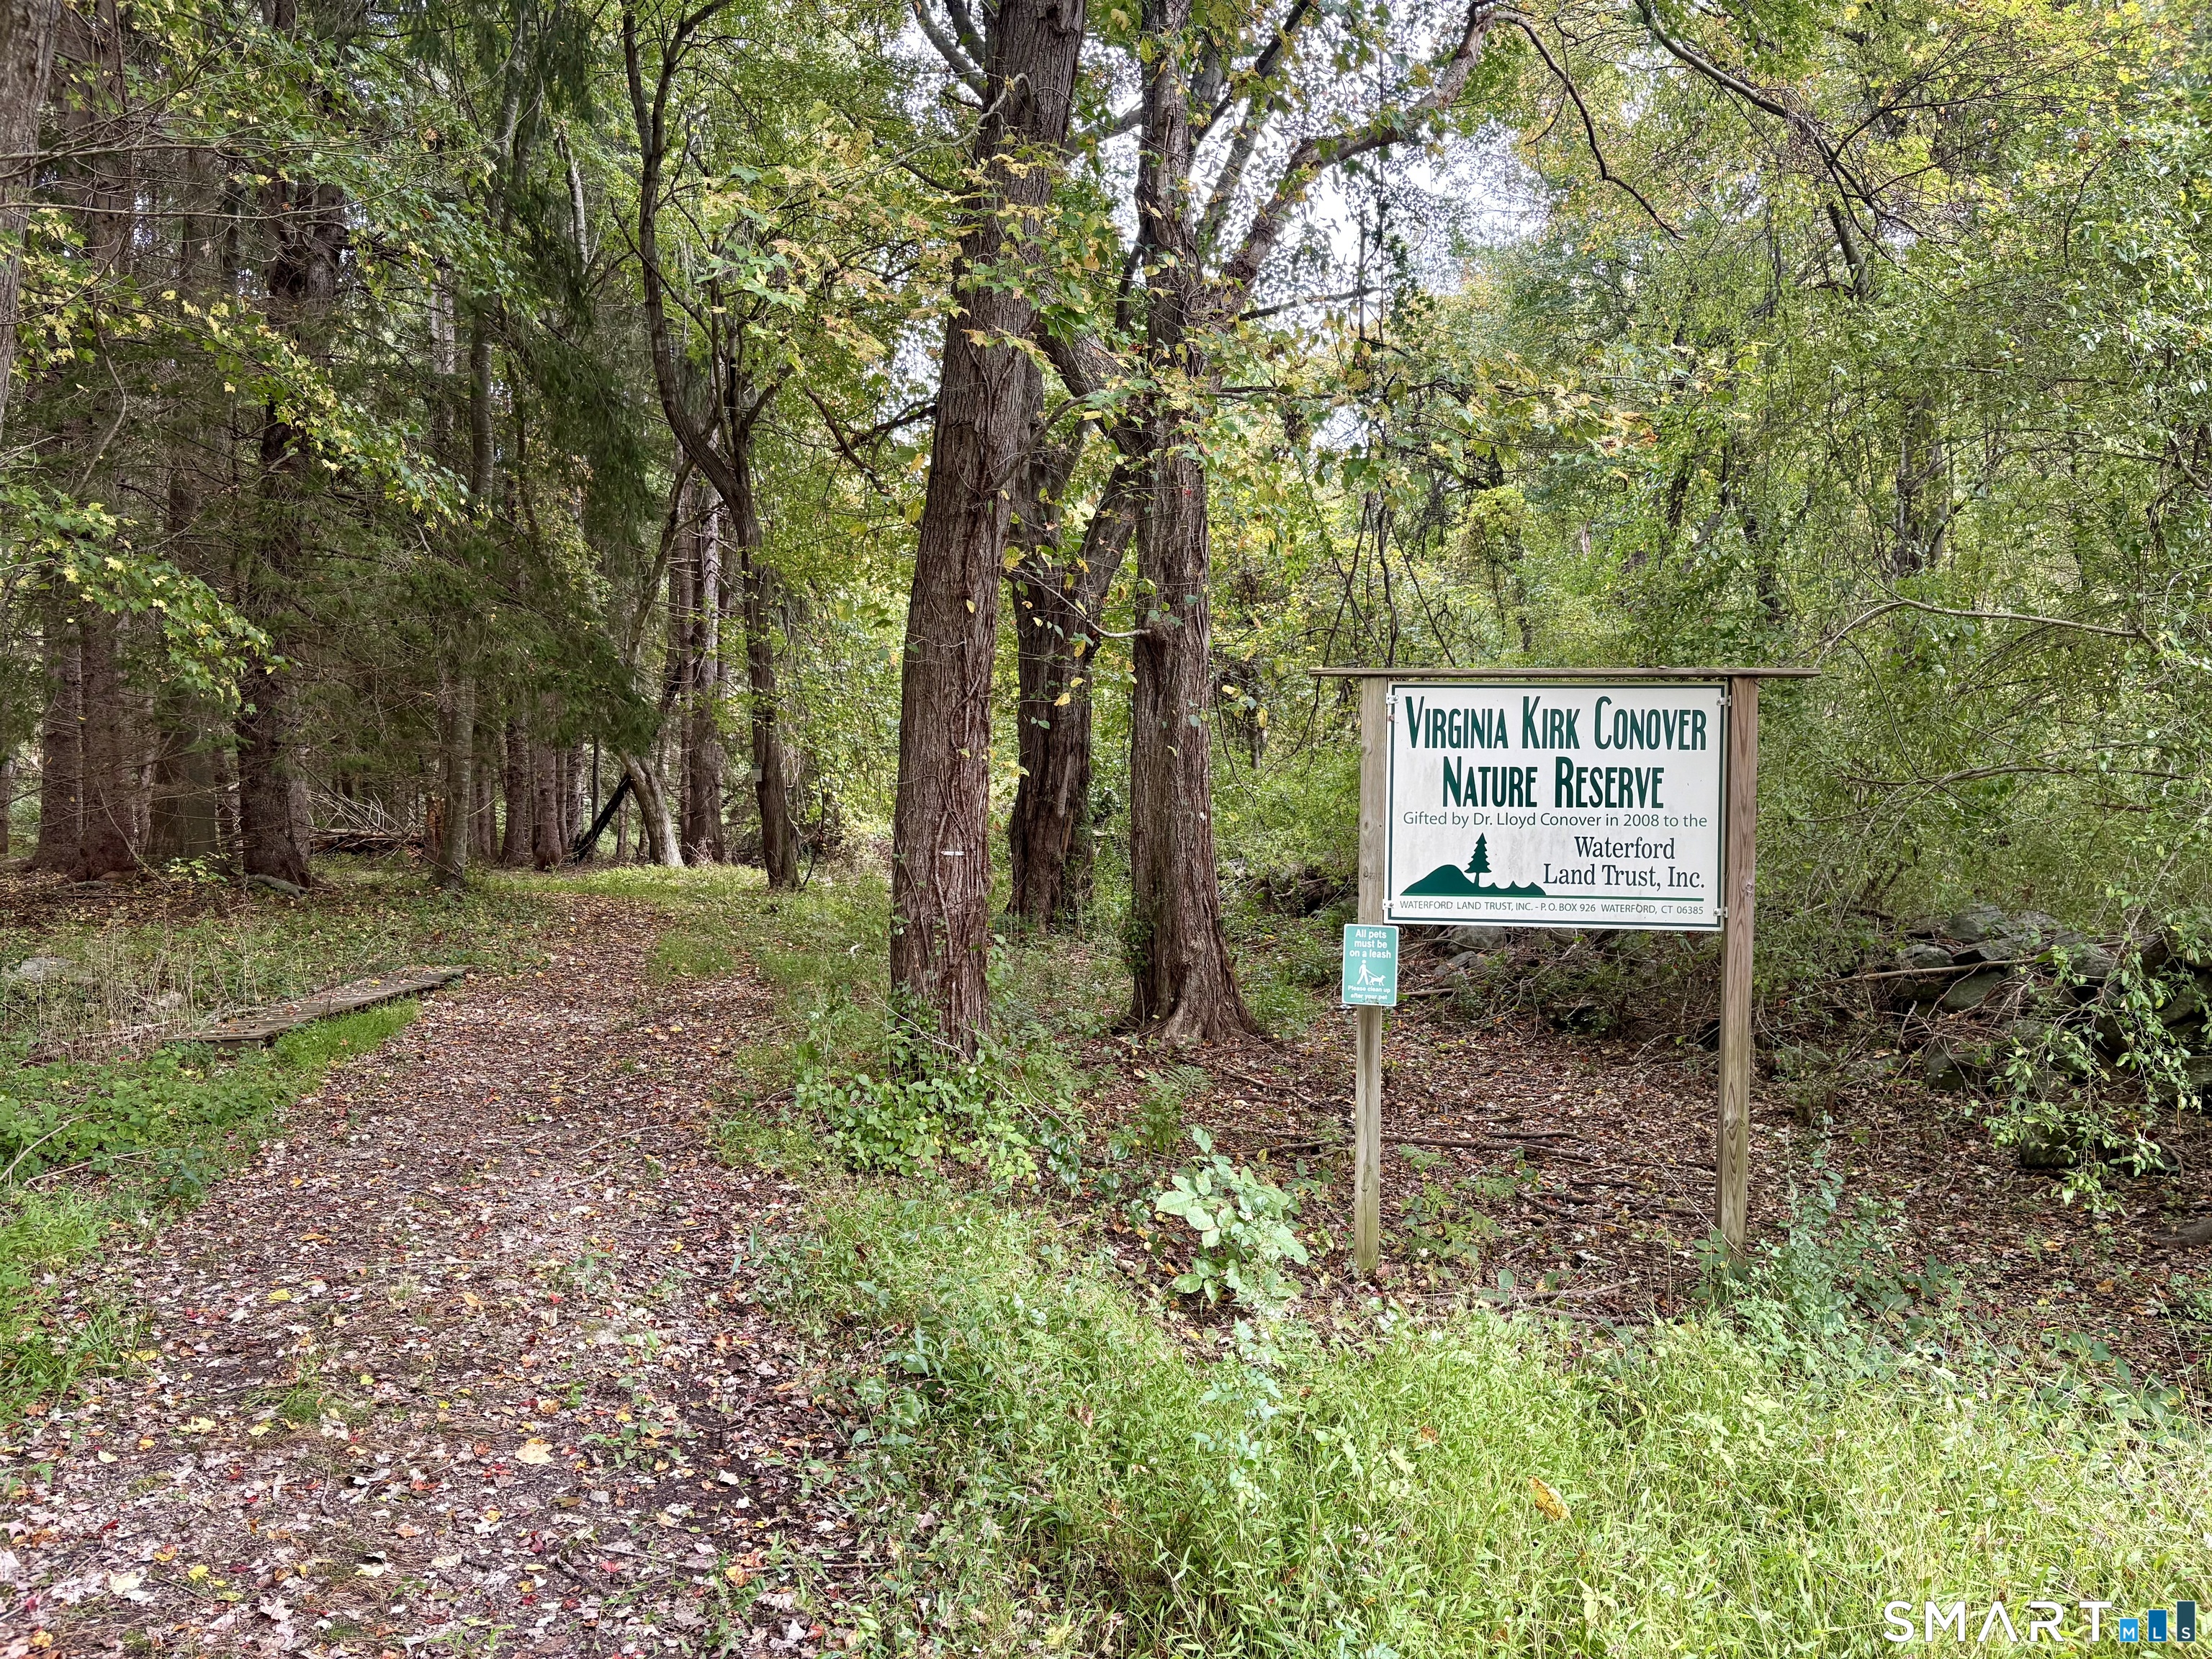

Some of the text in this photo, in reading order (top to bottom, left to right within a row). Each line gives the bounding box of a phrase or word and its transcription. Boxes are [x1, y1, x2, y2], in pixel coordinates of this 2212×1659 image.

[1405, 696, 1707, 750] VIRGINIA KIRK CONOVER
[1442, 756, 1665, 809] NATURE RESERVE
[1403, 811, 1707, 829] Gifted by Dr. Lloyd Conover in 2008 to the
[1574, 836, 1676, 860] Waterford
[1543, 863, 1705, 892] Land Trust, Inc.
[1400, 901, 1453, 909] WATERFORD
[1457, 902, 1481, 910] LAND
[1485, 902, 1514, 912] TRUST,
[1516, 902, 1533, 911] INC.
[1559, 903, 1578, 912] BOX
[1601, 904, 1658, 914] WATERFORD,
[1661, 905, 1673, 914] CT
[1676, 906, 1704, 914] 06385
[1355, 929, 1387, 940] All pets
[1354, 940, 1388, 948] must be
[1369, 949, 1391, 958] leash
